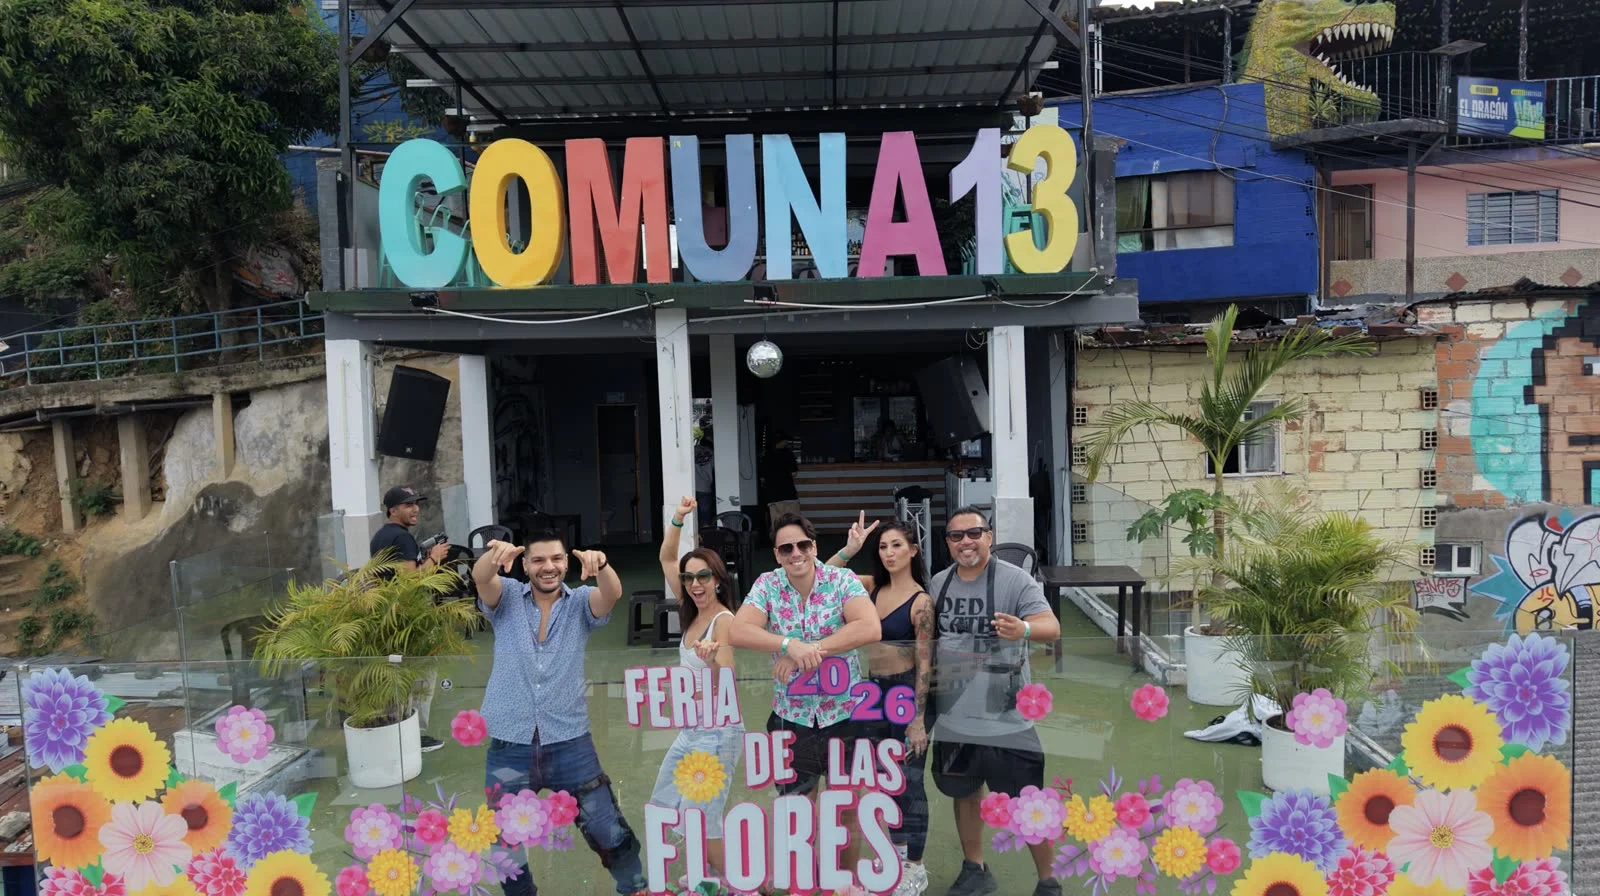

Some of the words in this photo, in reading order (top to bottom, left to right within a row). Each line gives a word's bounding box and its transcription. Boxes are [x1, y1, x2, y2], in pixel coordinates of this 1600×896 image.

[1459, 98, 1470, 117] EL
[1472, 97, 1508, 120] DRAGÓN
[378, 130, 948, 288] COMUNA
[949, 125, 1079, 277] 13
[624, 665, 743, 730] FERIA
[786, 656, 851, 697] 20
[849, 681, 917, 726] 26
[743, 730, 798, 789] DE
[828, 737, 907, 796] LAS
[643, 790, 904, 895] FLORES
